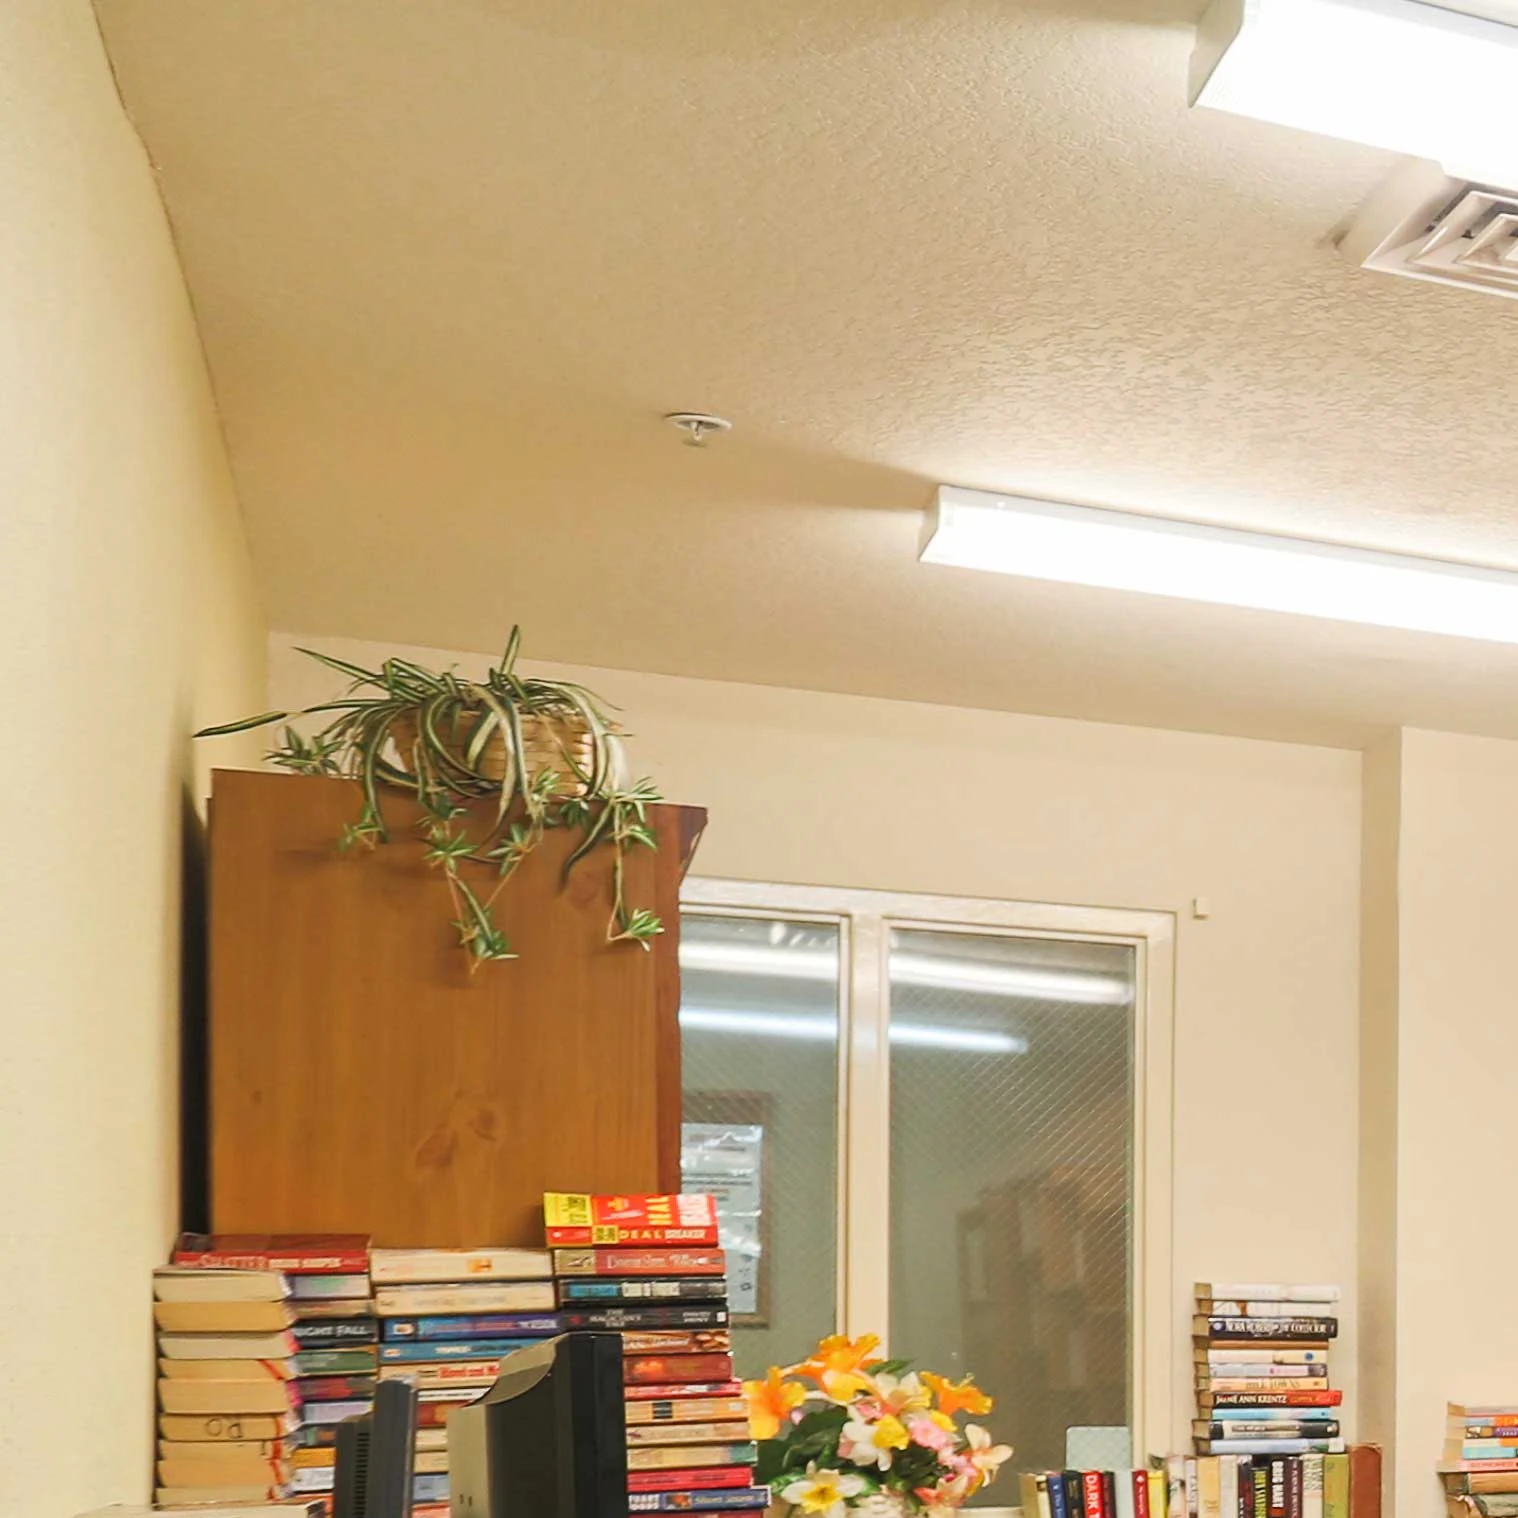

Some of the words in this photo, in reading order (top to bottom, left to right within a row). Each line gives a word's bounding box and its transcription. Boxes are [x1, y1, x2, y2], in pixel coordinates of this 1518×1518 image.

[619, 1230, 661, 1239] DEAL
[664, 1228, 705, 1239] BREAKER
[1084, 1473, 1098, 1504] DARK
